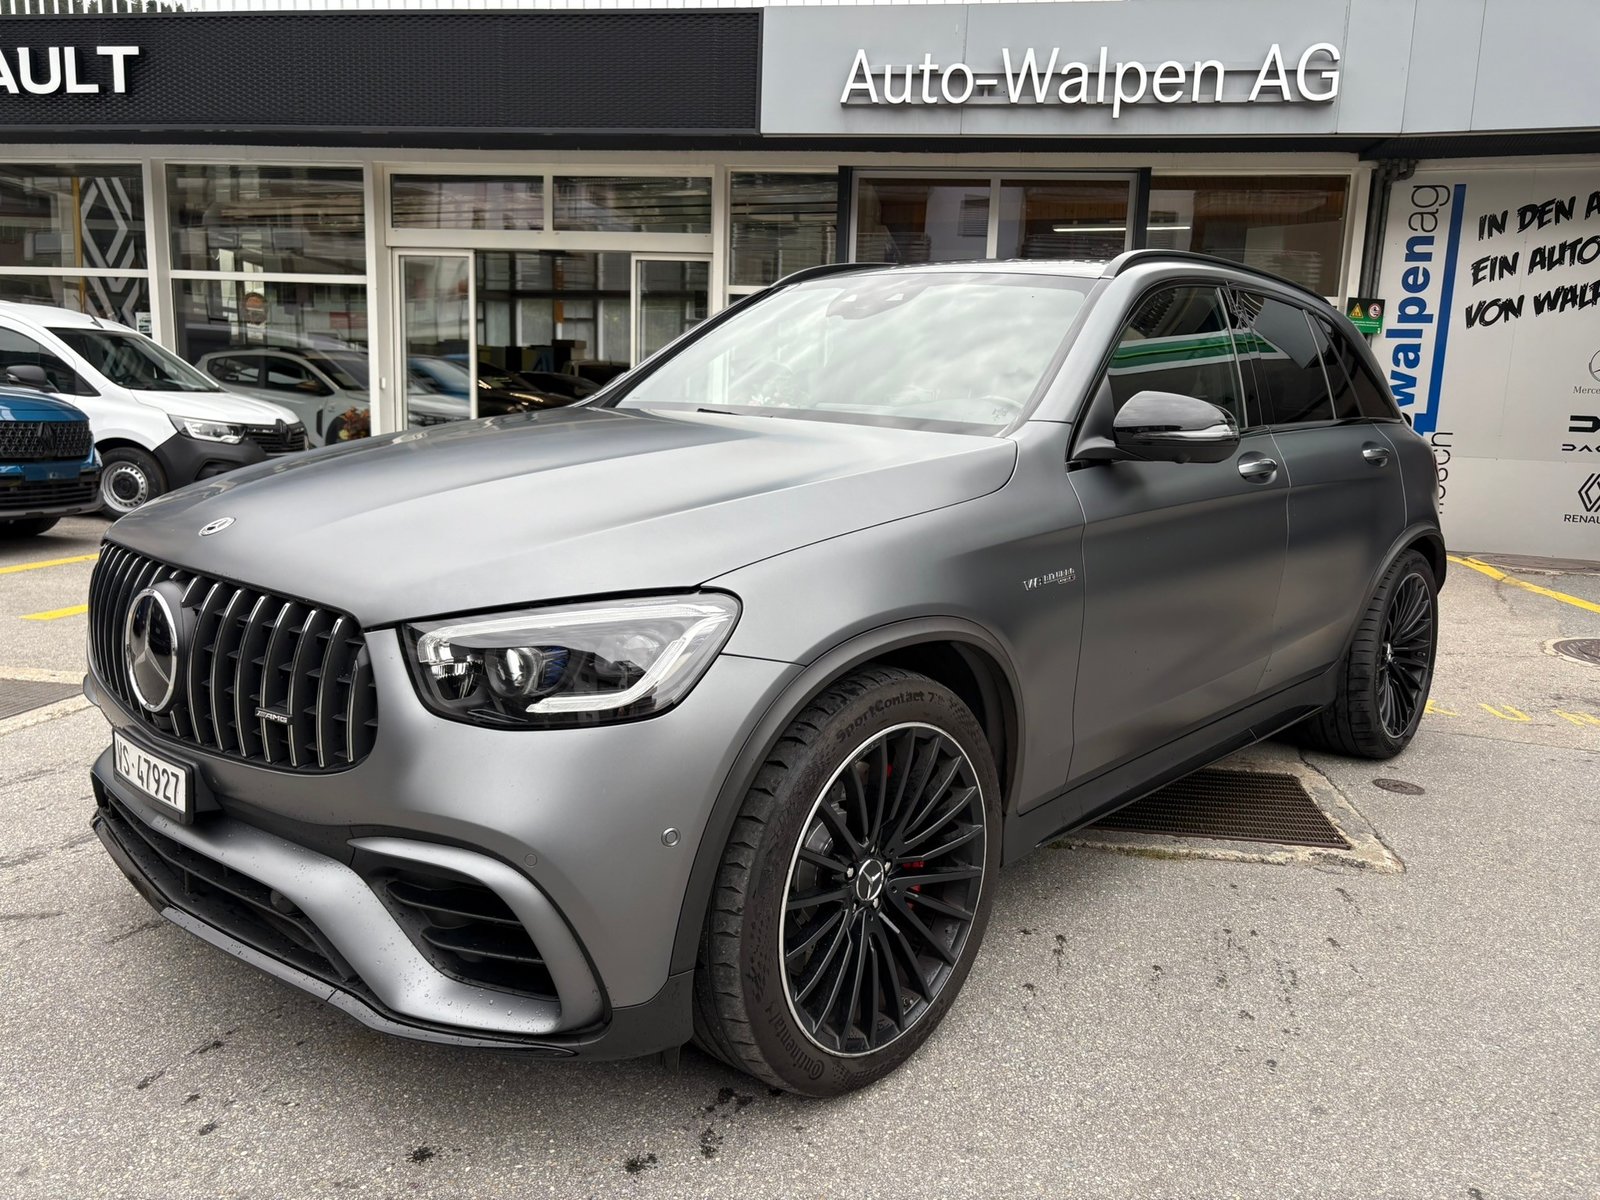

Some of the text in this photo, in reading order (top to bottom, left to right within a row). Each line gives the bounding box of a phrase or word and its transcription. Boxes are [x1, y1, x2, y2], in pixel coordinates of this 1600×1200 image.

[839, 42, 1341, 119] Auto-Walpen AG
[1478, 209, 1509, 242] IN
[1517, 195, 1577, 234] DEN
[1470, 235, 1600, 287] EIN AUTO
[1465, 294, 1525, 330] VON
[836, 690, 925, 742] SportContact
